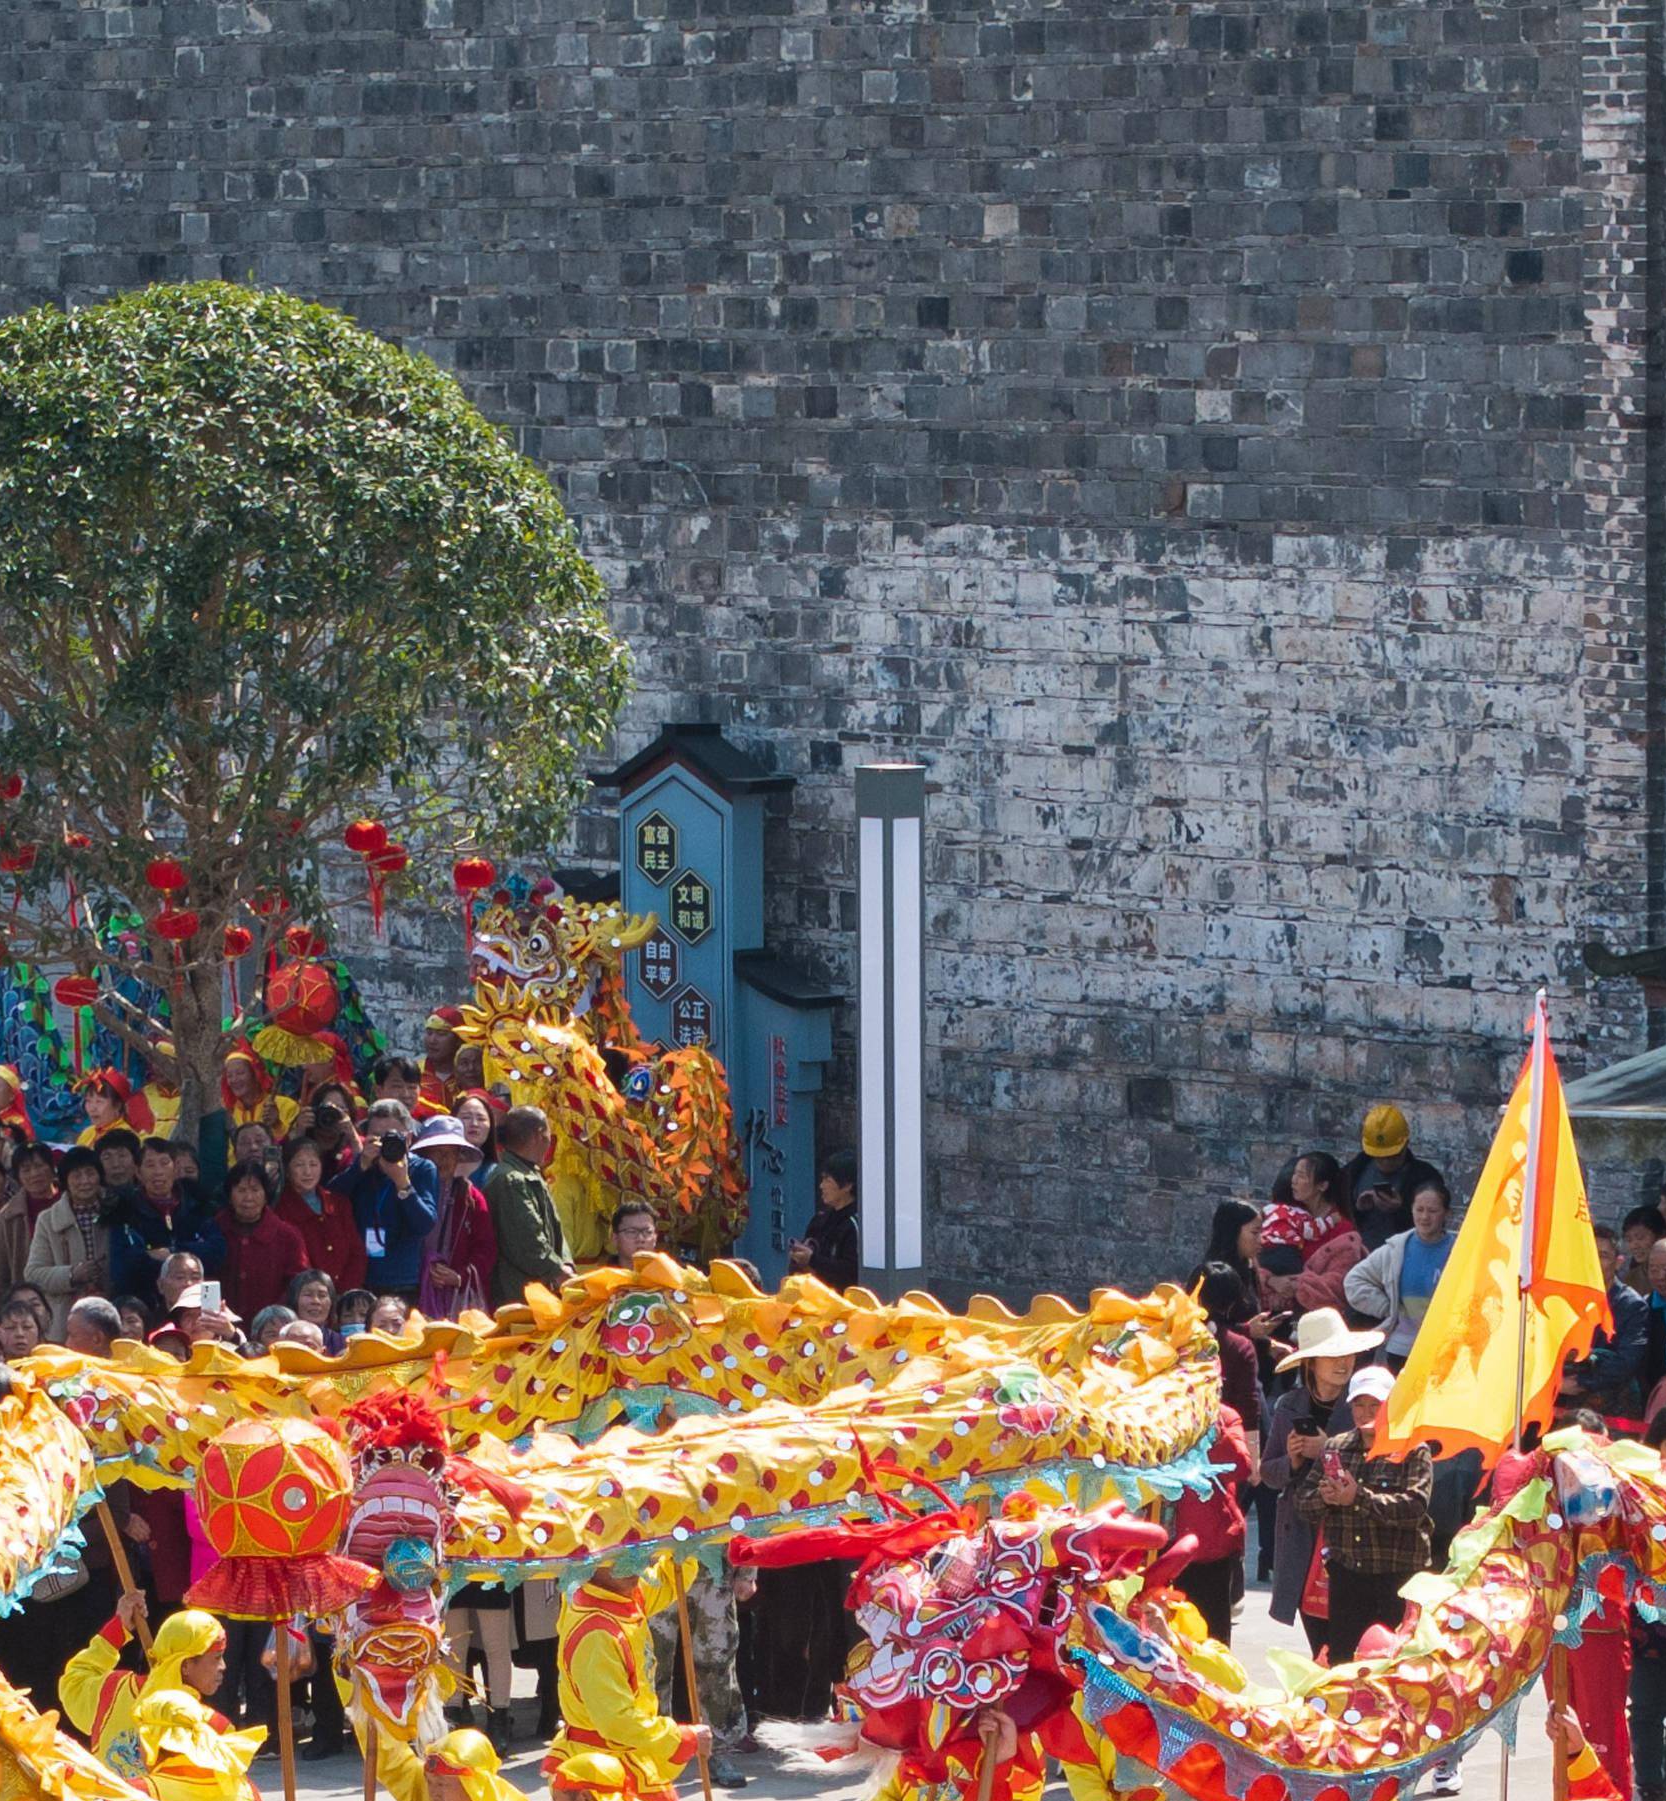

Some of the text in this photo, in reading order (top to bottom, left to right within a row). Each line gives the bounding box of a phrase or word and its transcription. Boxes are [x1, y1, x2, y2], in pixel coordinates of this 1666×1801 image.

[643, 825, 669, 845] 富强
[644, 850, 670, 870] 民主
[677, 884, 704, 905] 文明
[678, 910, 704, 930] 和谐
[645, 940, 671, 959] 自由
[645, 965, 671, 984] 平等
[679, 1000, 705, 1019] 公正
[679, 1025, 705, 1044] 法治
